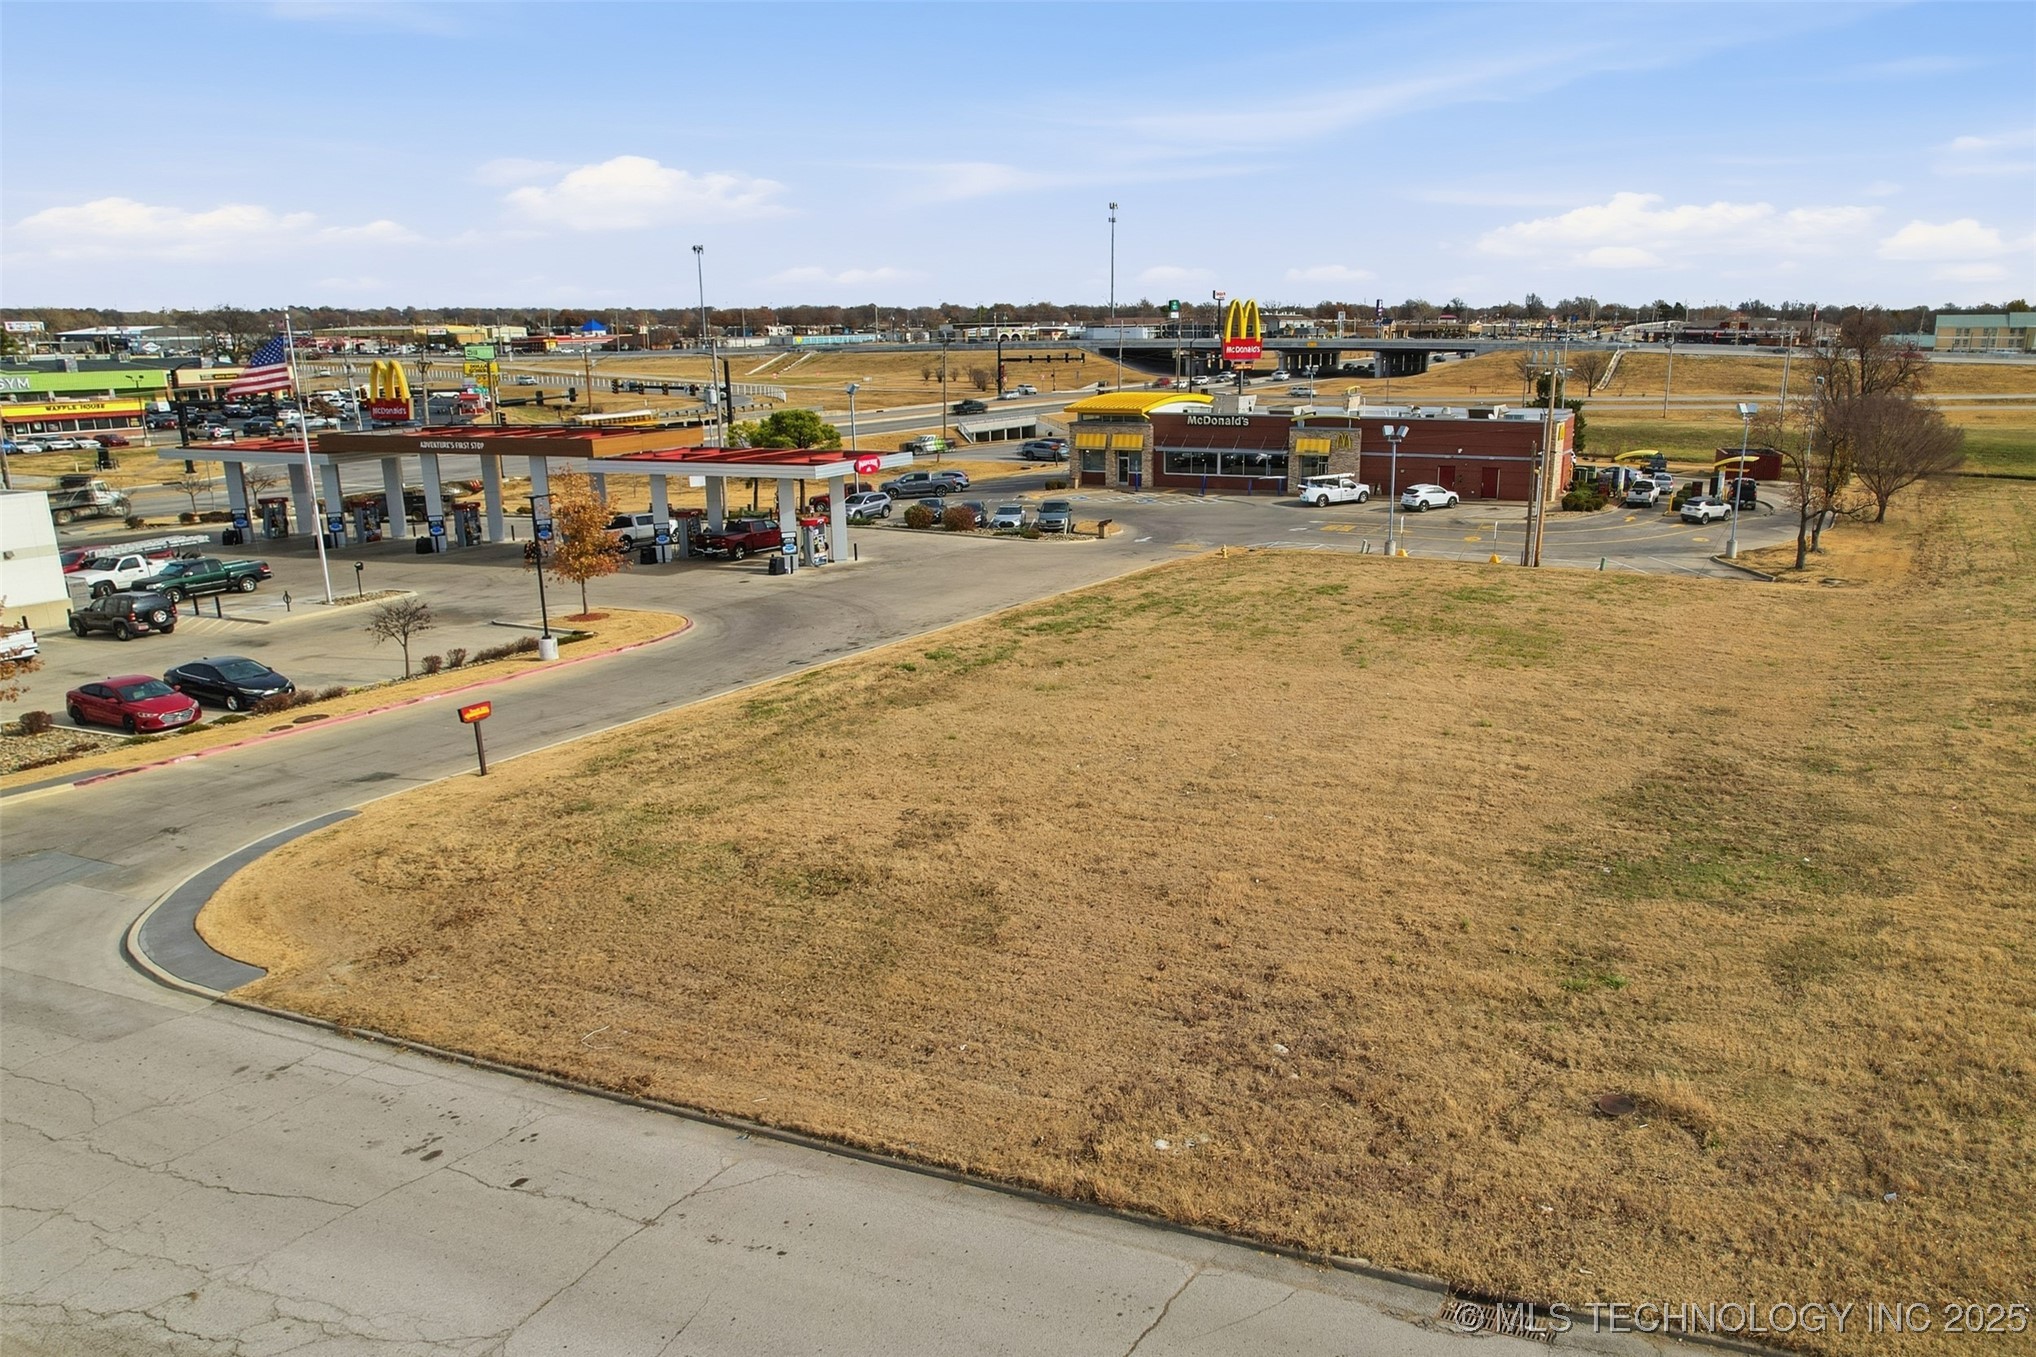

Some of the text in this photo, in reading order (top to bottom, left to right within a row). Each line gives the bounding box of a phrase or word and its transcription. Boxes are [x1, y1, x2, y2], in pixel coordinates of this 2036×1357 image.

[1226, 345, 1261, 354] McDonald's
[45, 402, 106, 412] WAFFLE HOUSE
[1187, 415, 1249, 426] McDonald's
[470, 441, 485, 450] STOP
